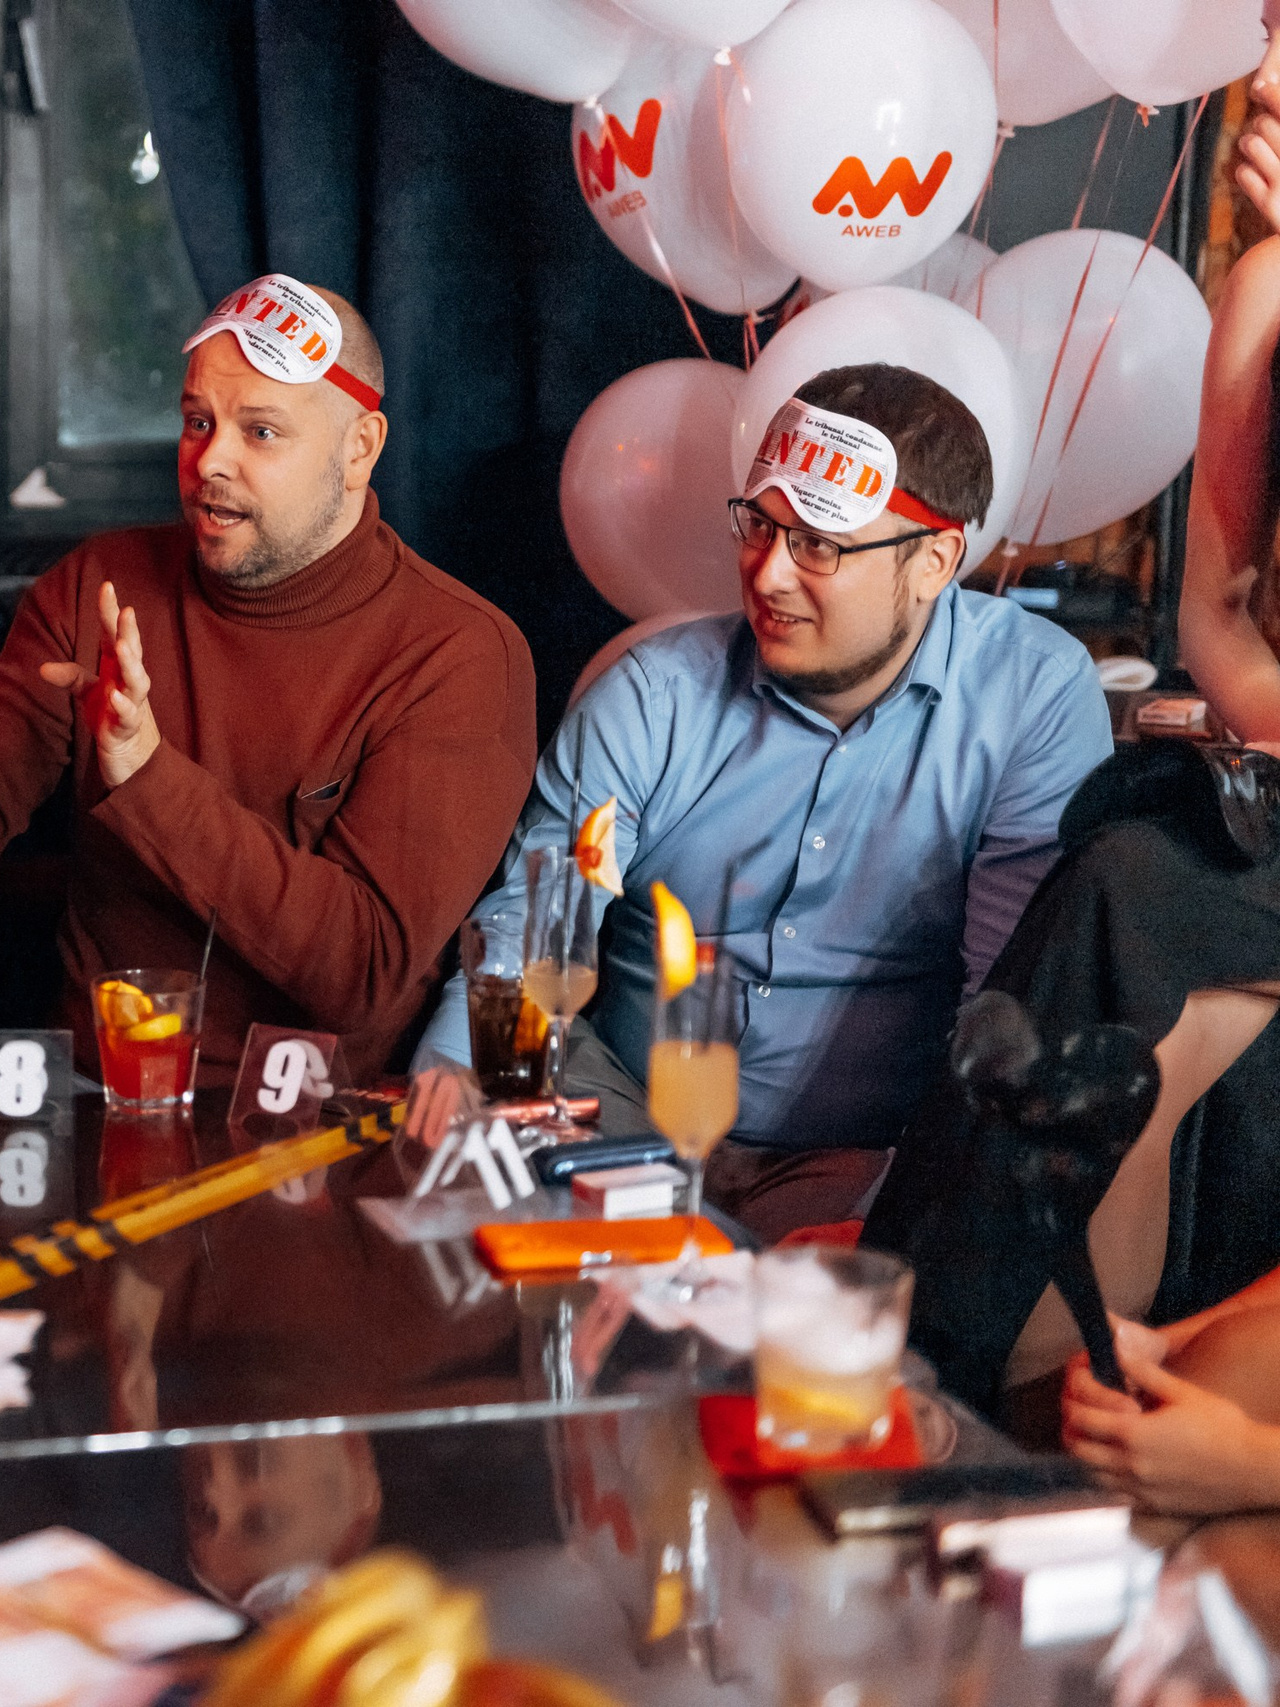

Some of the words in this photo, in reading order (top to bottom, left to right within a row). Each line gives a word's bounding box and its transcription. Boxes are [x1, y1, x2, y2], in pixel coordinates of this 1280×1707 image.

[841, 224, 902, 238] AWEB
[814, 420, 845, 436] tribunal
[829, 433, 860, 450] tribunal
[817, 496, 842, 511] moins
[257, 1040, 308, 1113] 9
